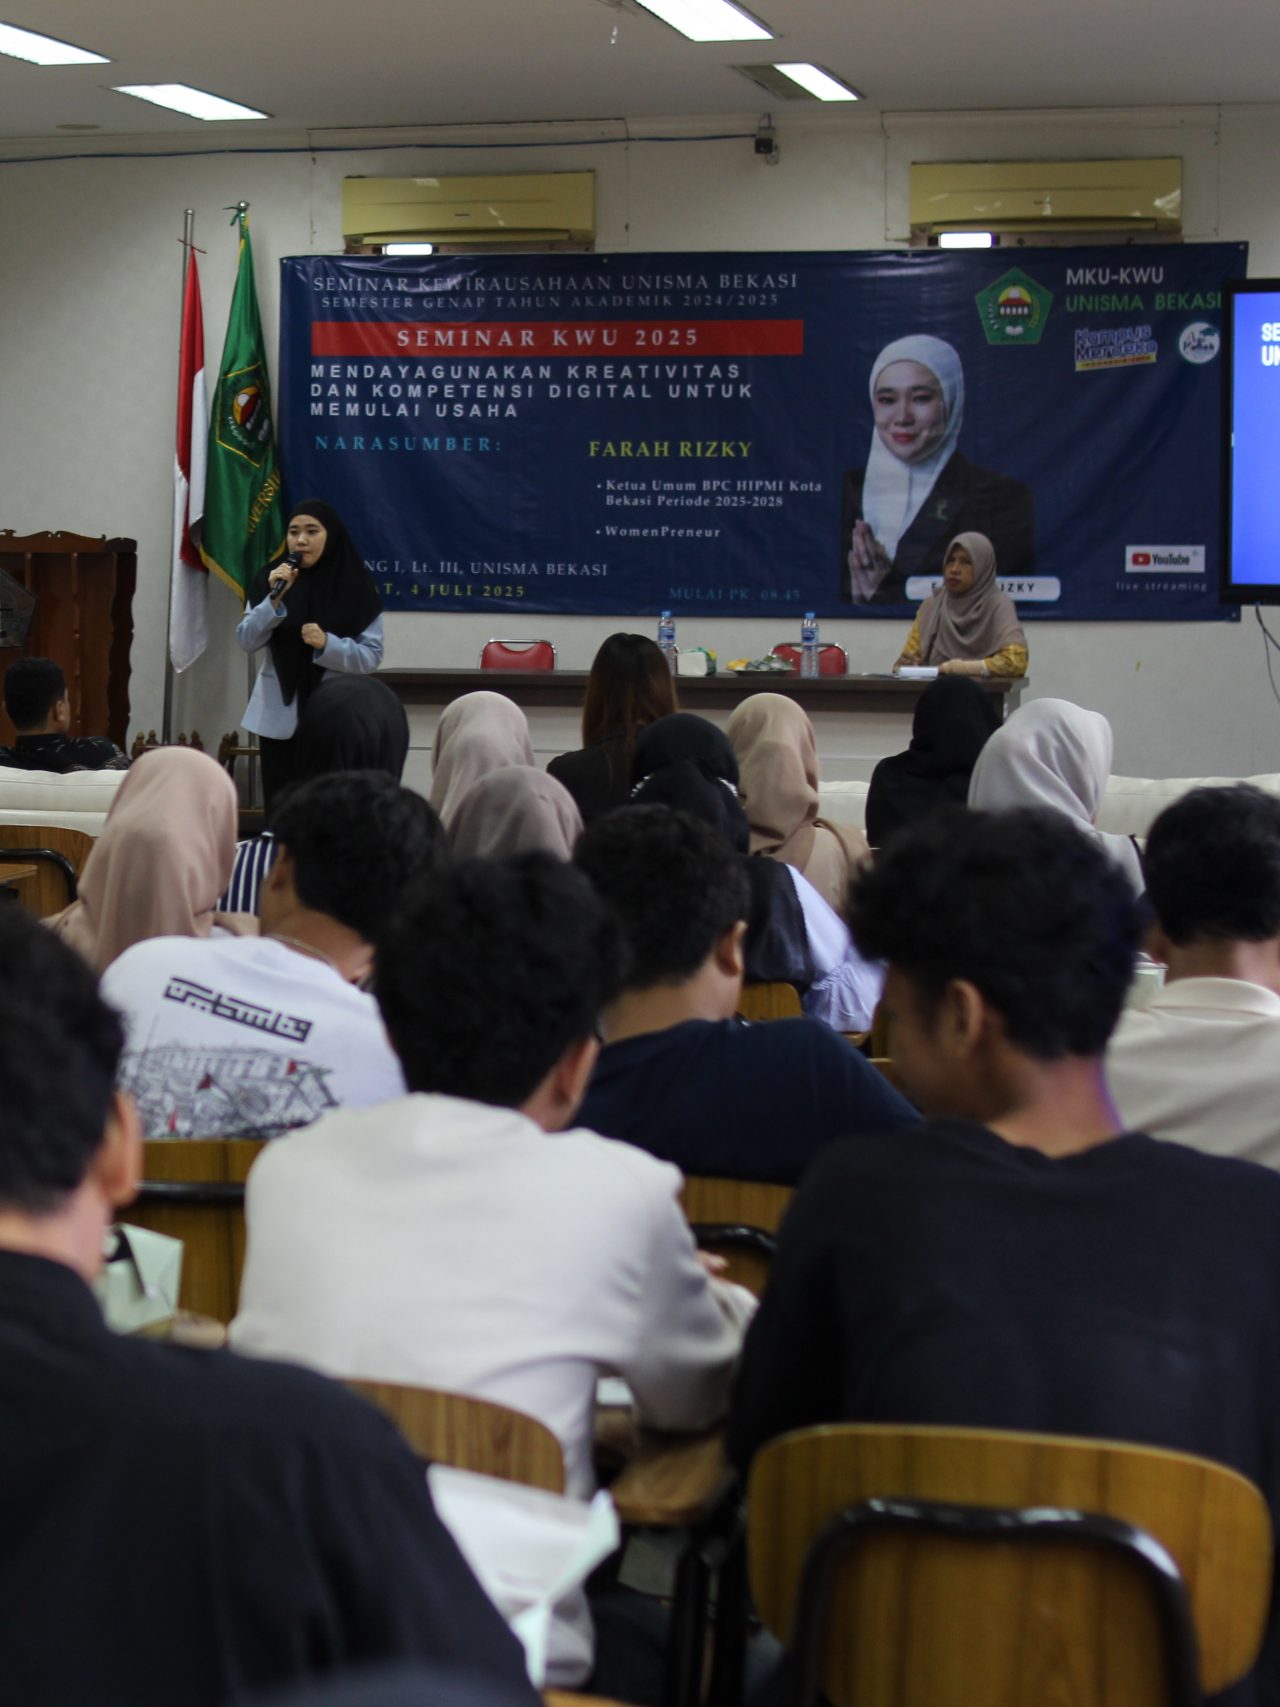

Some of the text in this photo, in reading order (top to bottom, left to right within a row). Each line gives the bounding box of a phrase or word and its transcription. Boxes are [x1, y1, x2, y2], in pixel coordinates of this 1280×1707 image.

[313, 272, 797, 292] SEMINAR KEWIRAUSAHAAN UNISMA BEKASI
[1066, 266, 1164, 285] MKU-KWU
[321, 294, 779, 308] SEMESTER GENAP TAHUN AKADEMIK 2024/2025
[1066, 291, 1221, 313] UNISMA BEKASI
[396, 329, 698, 347] SEMINAR KWU 2025
[310, 363, 740, 379] MENDAYAGUNAKAN KREATIVITAS
[310, 383, 752, 398] DAN KOMPETENSI DIGITAL UNTUK
[310, 403, 518, 418] MEMULAI USAHA
[314, 435, 501, 452] NARASUMBER:
[588, 440, 753, 458] FARAH RIZKY
[606, 479, 823, 493] Ketua Umum BPC HIPMI Kota
[605, 494, 784, 508] Bekasi Periode 2025-2028
[605, 525, 721, 538] WomenPreneur
[1152, 552, 1190, 566] YouTube
[412, 560, 432, 574] Lt.
[470, 562, 539, 576] UNISMA
[545, 563, 608, 577] BEKASI
[410, 584, 419, 596] 4
[428, 584, 472, 598] JULI
[483, 585, 525, 597] 2025
[669, 587, 723, 600] MULAI
[1001, 582, 1036, 593] IZKY
[1115, 581, 1208, 593] live streaming
